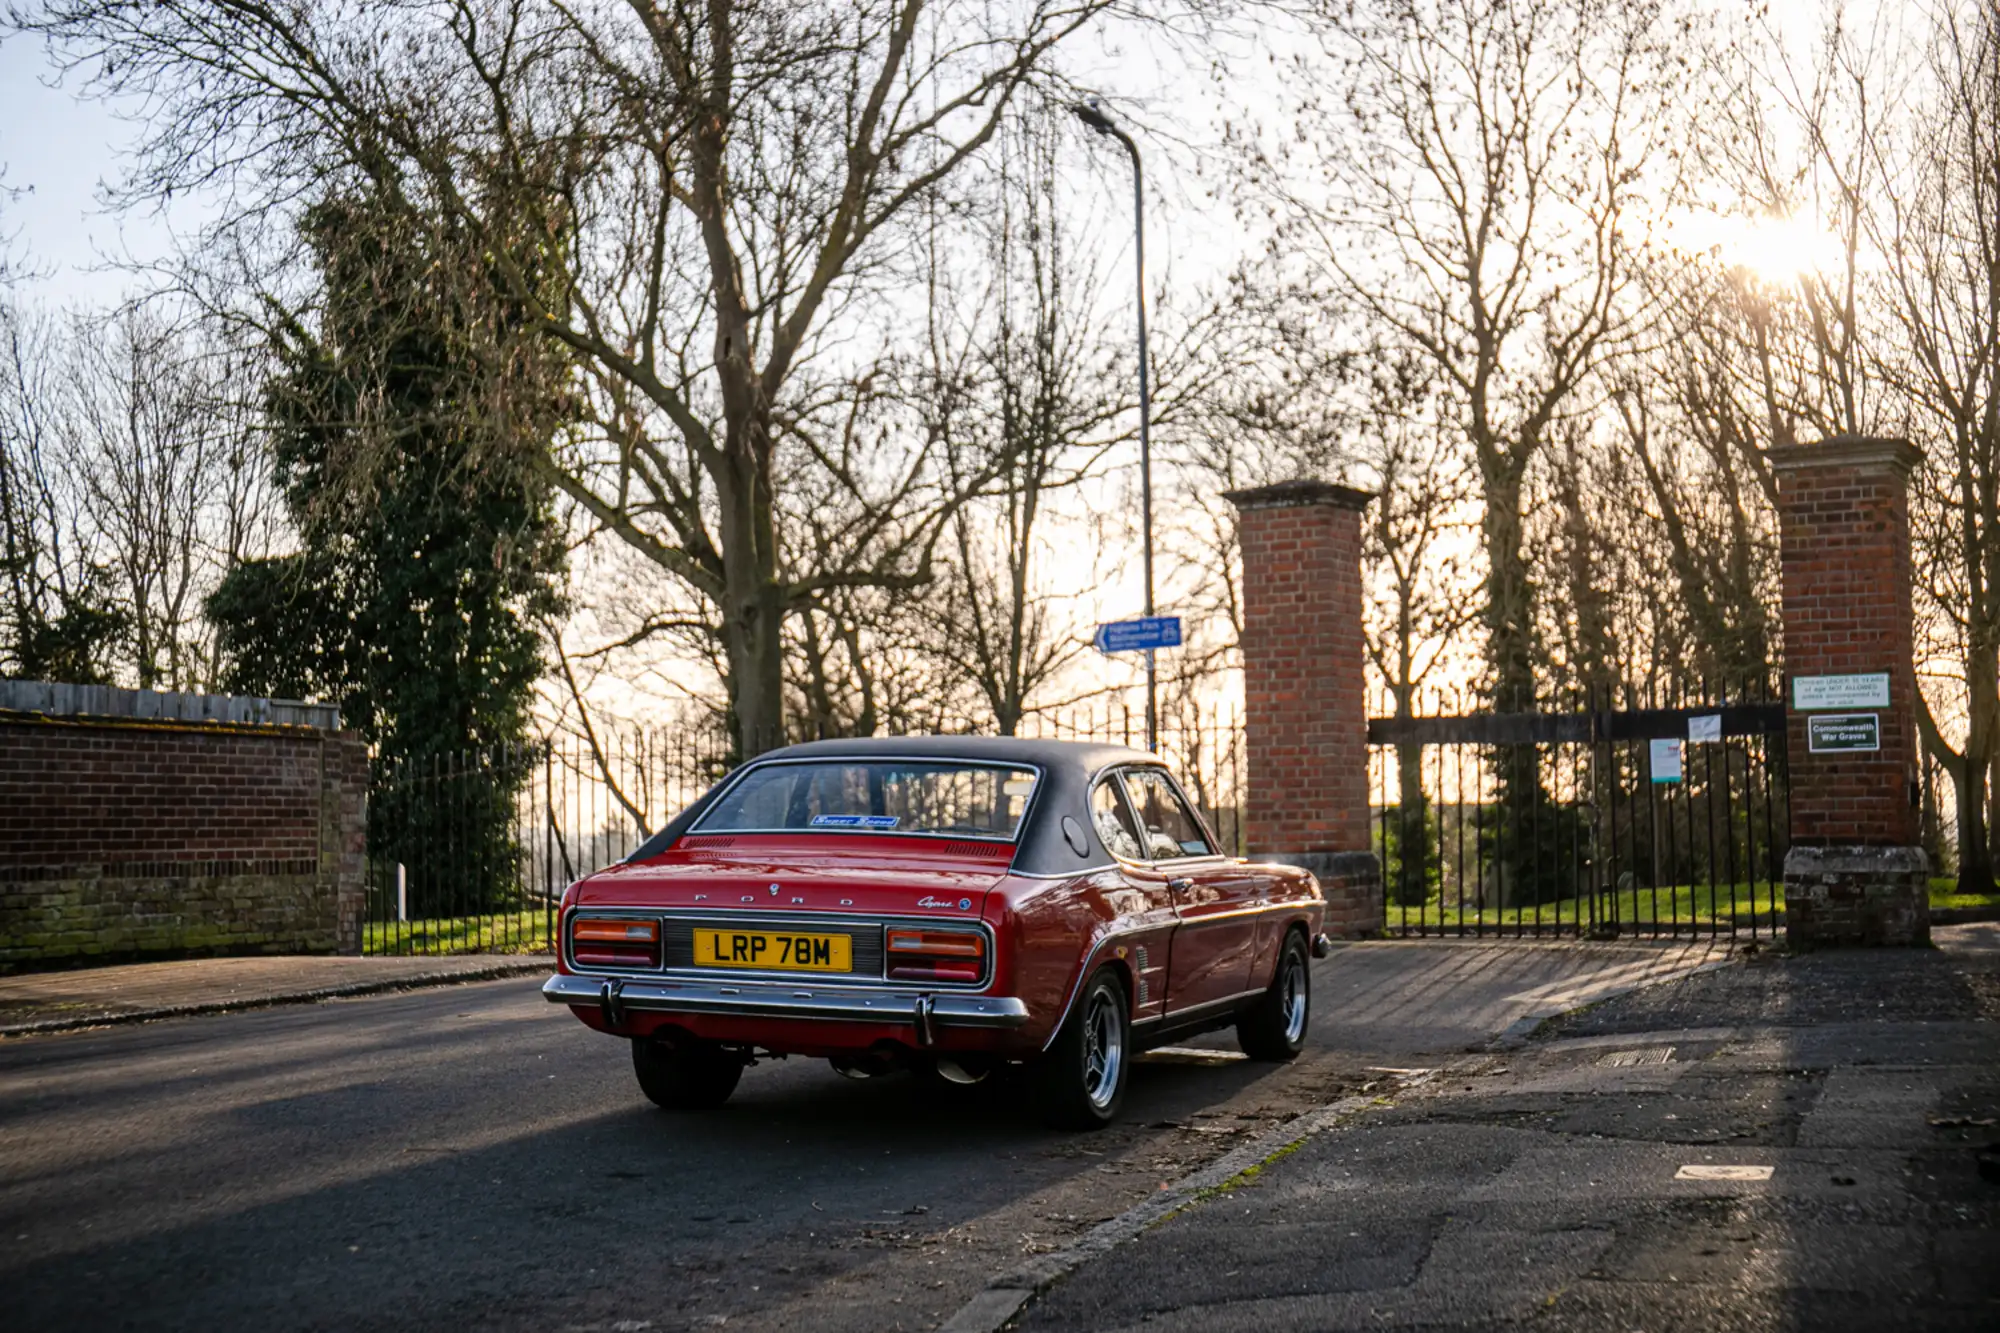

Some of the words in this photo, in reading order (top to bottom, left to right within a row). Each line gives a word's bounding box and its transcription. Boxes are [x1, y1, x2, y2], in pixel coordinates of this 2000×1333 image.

[1845, 683, 1878, 691] ALLOWED
[1812, 723, 1875, 733] Commonwealth
[1821, 733, 1837, 741] War
[1838, 732, 1867, 741] Graves
[695, 894, 853, 906] FORD
[714, 934, 767, 962] LRP
[776, 937, 831, 965] 78M
